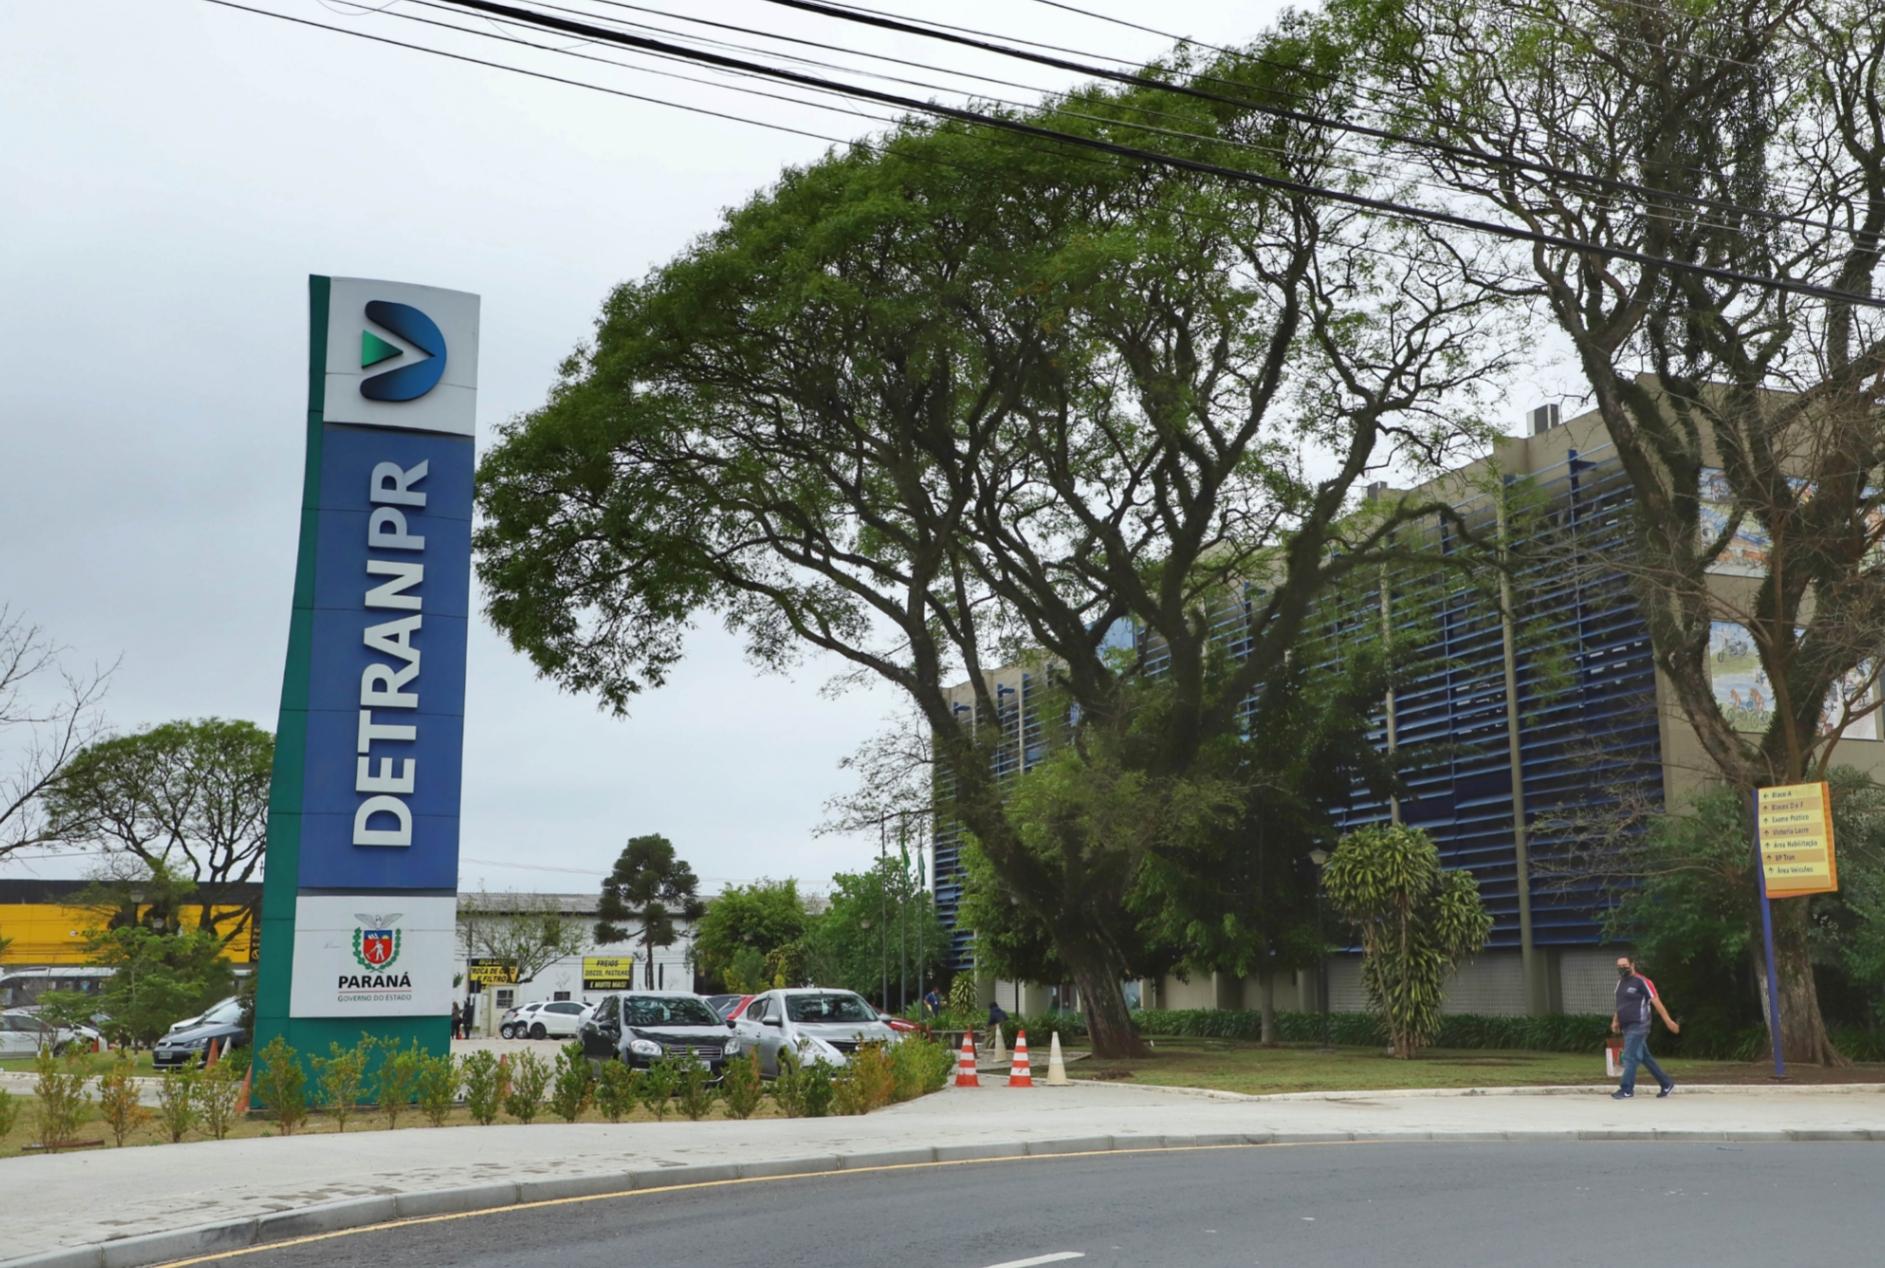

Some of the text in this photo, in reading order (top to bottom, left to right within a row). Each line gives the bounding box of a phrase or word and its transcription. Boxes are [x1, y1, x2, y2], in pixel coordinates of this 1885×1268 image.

[338, 971, 412, 988] PARANÁ
[337, 994, 373, 1002] GOVERNO
[385, 993, 412, 1001] ESTADO
